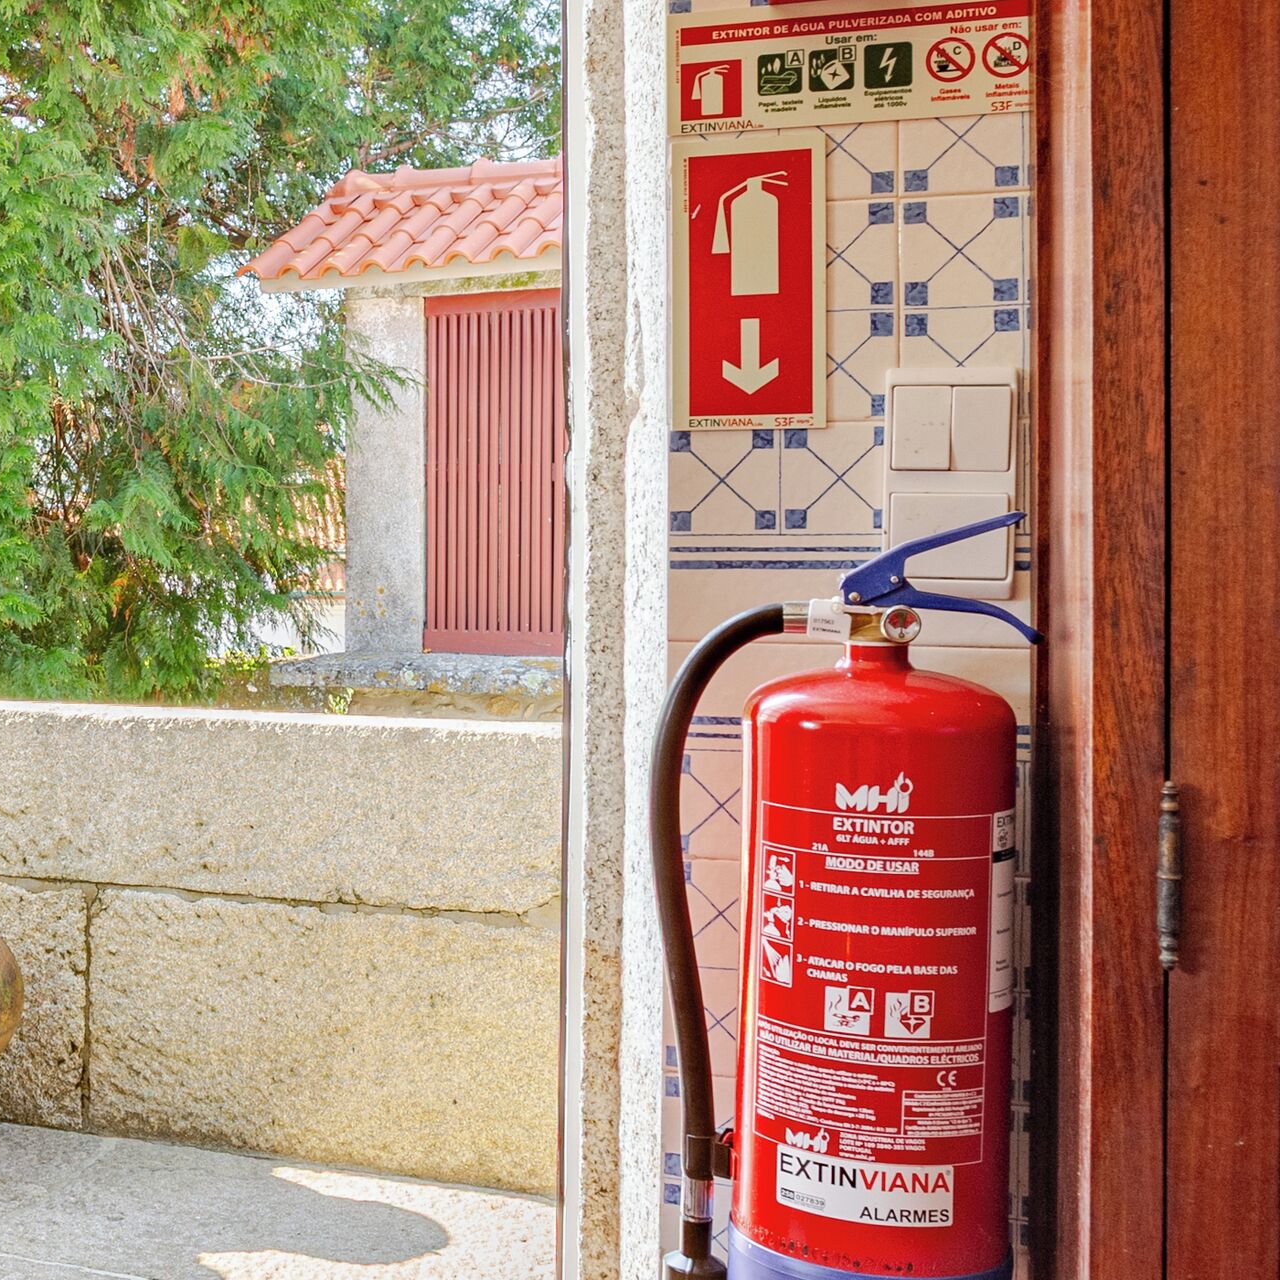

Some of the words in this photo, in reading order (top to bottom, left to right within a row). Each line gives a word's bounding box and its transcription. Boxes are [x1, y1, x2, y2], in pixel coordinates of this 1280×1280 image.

[712, 26, 770, 40] EXTINTOR
[773, 24, 789, 35] DE
[792, 20, 825, 33] ÁGUA
[828, 14, 911, 30] PULVERIZADA
[915, 11, 942, 22] COM
[945, 6, 997, 20] ADITIVO
[950, 24, 971, 34] Não
[975, 23, 998, 32] usar
[1001, 21, 1022, 30] em:
[825, 35, 852, 45] Usar
[856, 34, 877, 42] em:
[1013, 41, 1022, 51] D
[842, 48, 853, 60] B
[953, 45, 962, 56] C
[790, 52, 801, 64] A
[864, 88, 912, 97] Equipamentos
[994, 82, 1019, 90] Metais
[991, 101, 1013, 111] S3F
[681, 120, 754, 133] EXTINVIANA
[689, 418, 753, 428] EXTINVIANA
[774, 417, 795, 427] S3F
[833, 817, 914, 835] EXTINTOR
[836, 834, 851, 843] 6LT
[852, 834, 878, 845] ÁGUA
[887, 837, 910, 846] AFFF
[812, 842, 828, 852] 21A
[913, 849, 934, 858] 144B
[825, 857, 865, 871] MODO
[866, 859, 884, 871] DE
[886, 860, 919, 873] USAR
[810, 882, 850, 895] RETIRAR
[851, 887, 858, 895] A
[860, 887, 905, 899] CAVILHA
[908, 889, 920, 899] DE
[922, 888, 974, 900] SEGURANÇA
[809, 919, 869, 935] PRESSIONAR
[871, 926, 879, 935] O
[881, 925, 934, 937] MANÍPULO
[936, 926, 976, 936] SUPERIOR
[808, 957, 844, 970] ATACAR
[846, 962, 853, 970] O
[855, 962, 885, 973] FOGO
[887, 965, 912, 974] PELA
[913, 965, 938, 975] BASE
[940, 965, 958, 975] DAS
[807, 968, 848, 982] CHAMAS
[850, 992, 870, 1010] A
[913, 995, 930, 1013] B
[772, 1024, 807, 1041] UTILIZAÇÃO
[815, 1036, 838, 1047] LOCAL
[840, 1040, 860, 1050] DEVE
[861, 1043, 876, 1051] SER
[760, 1029, 774, 1042] NÃO
[775, 1035, 811, 1052] UTILIZAR
[812, 1046, 826, 1055] EM
[828, 1048, 929, 1064] MATERIAL/QUADROS
[931, 1054, 979, 1064] ELÉCTRICOS
[780, 1152, 950, 1194] EXTINVIANA
[860, 1206, 950, 1224] ALARMES
